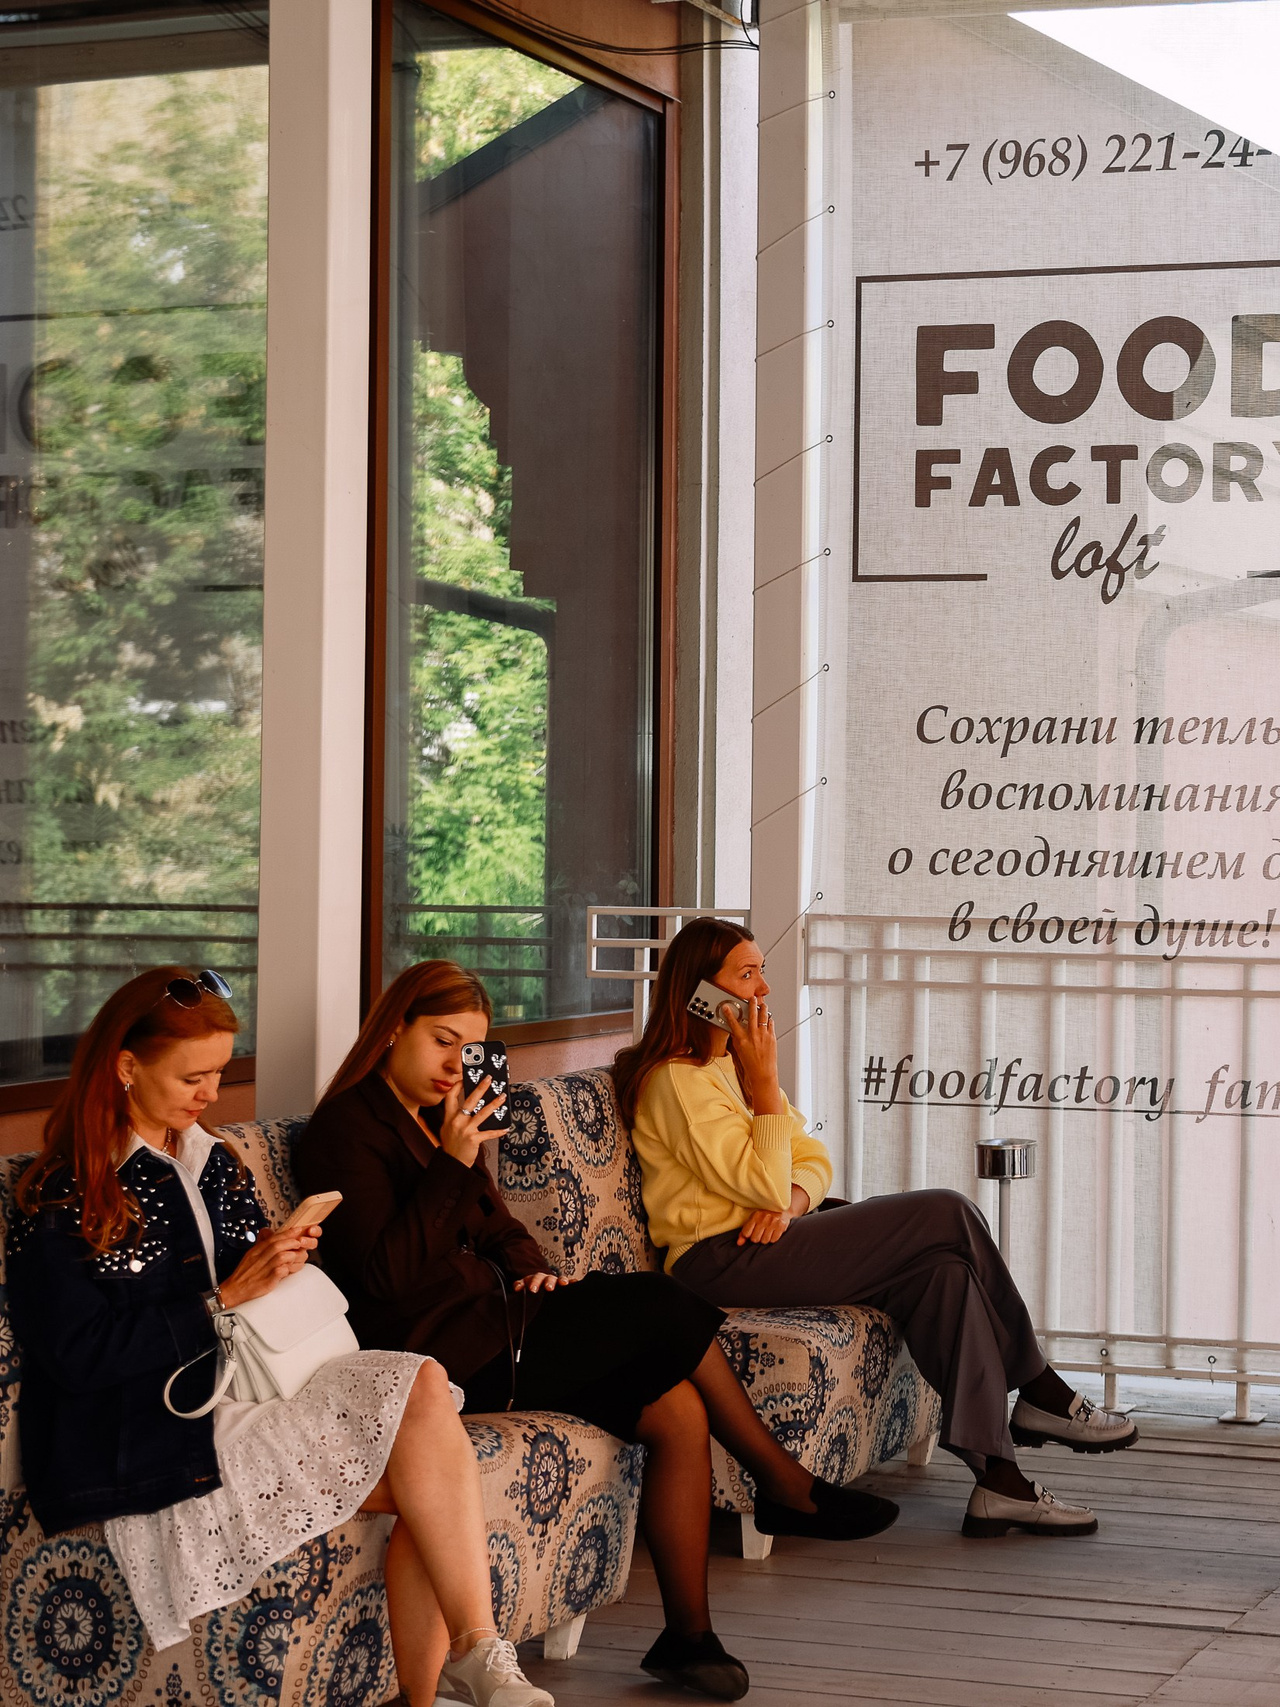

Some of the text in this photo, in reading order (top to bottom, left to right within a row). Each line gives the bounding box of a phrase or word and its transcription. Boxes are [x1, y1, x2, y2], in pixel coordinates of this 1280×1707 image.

[914, 142, 970, 182] +7
[981, 133, 1089, 186] (968)
[1050, 513, 1166, 605] loft
[915, 705, 1119, 758] Сохрани
[887, 847, 914, 876] о
[928, 835, 1246, 880] сегодняшнем
[947, 901, 1278, 961] в своей душе!
